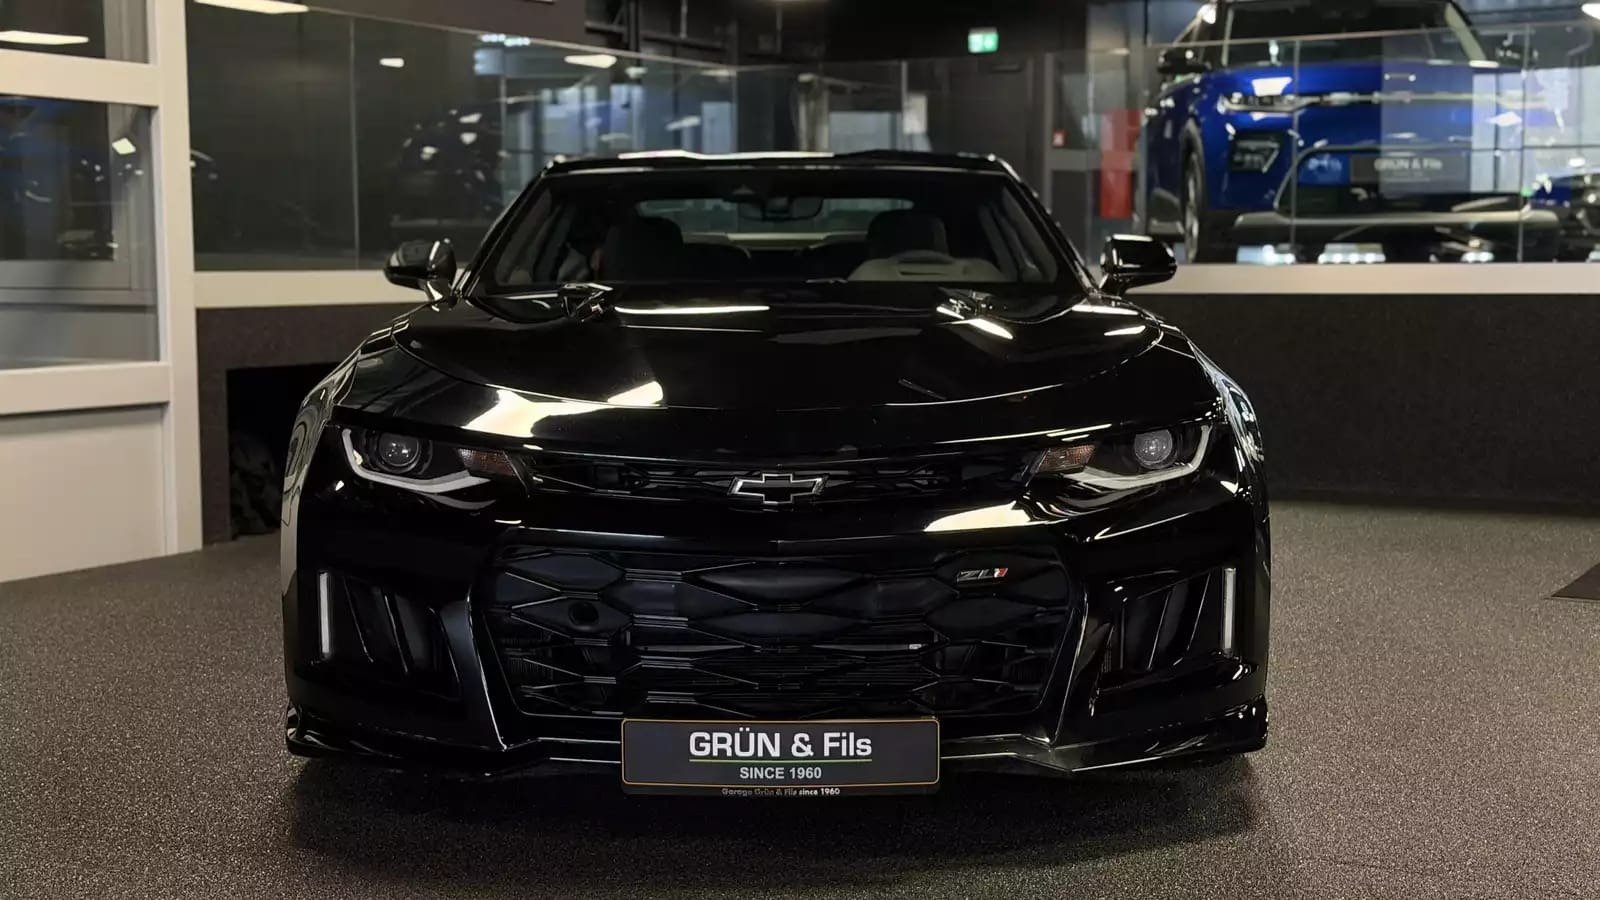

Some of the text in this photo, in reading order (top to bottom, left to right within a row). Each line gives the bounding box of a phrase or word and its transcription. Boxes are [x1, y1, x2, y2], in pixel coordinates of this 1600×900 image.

[689, 727, 873, 758] GRÜN & Fils
[739, 767, 823, 780] SINCE 1960
[799, 787, 818, 796] since
[820, 787, 840, 796] 1960
